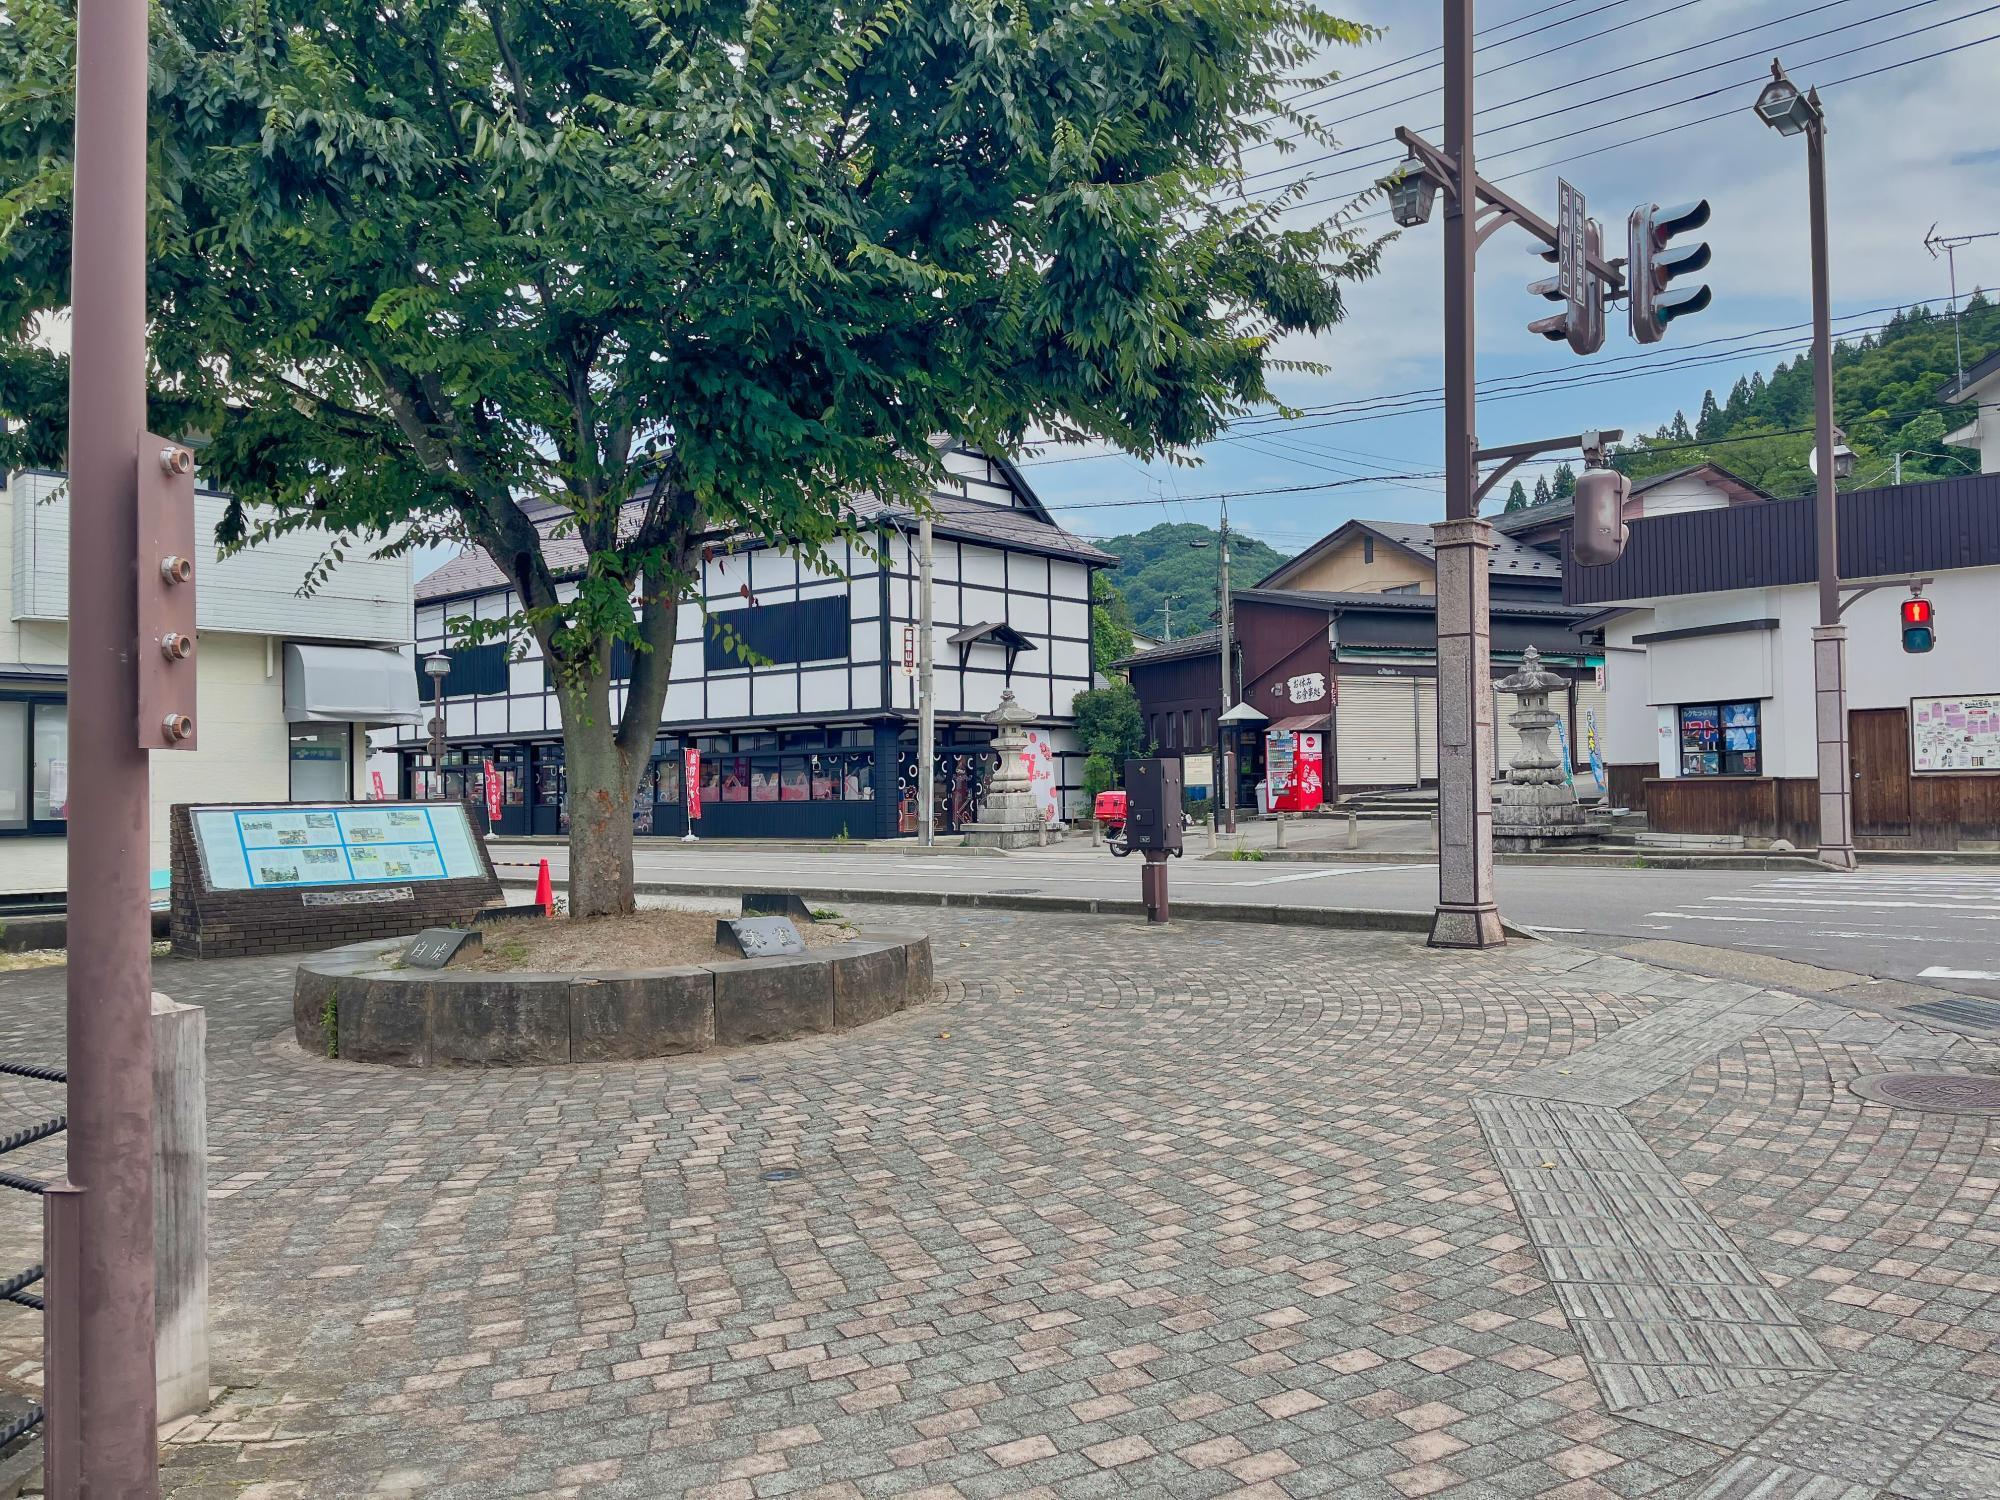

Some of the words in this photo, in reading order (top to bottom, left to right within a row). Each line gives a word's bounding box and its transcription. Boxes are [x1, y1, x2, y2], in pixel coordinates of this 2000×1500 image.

[1293, 677, 1312, 689] お休み
[1296, 687, 1321, 700] お食事処
[745, 928, 798, 949] 朱雀
[410, 941, 449, 961] 白虎
